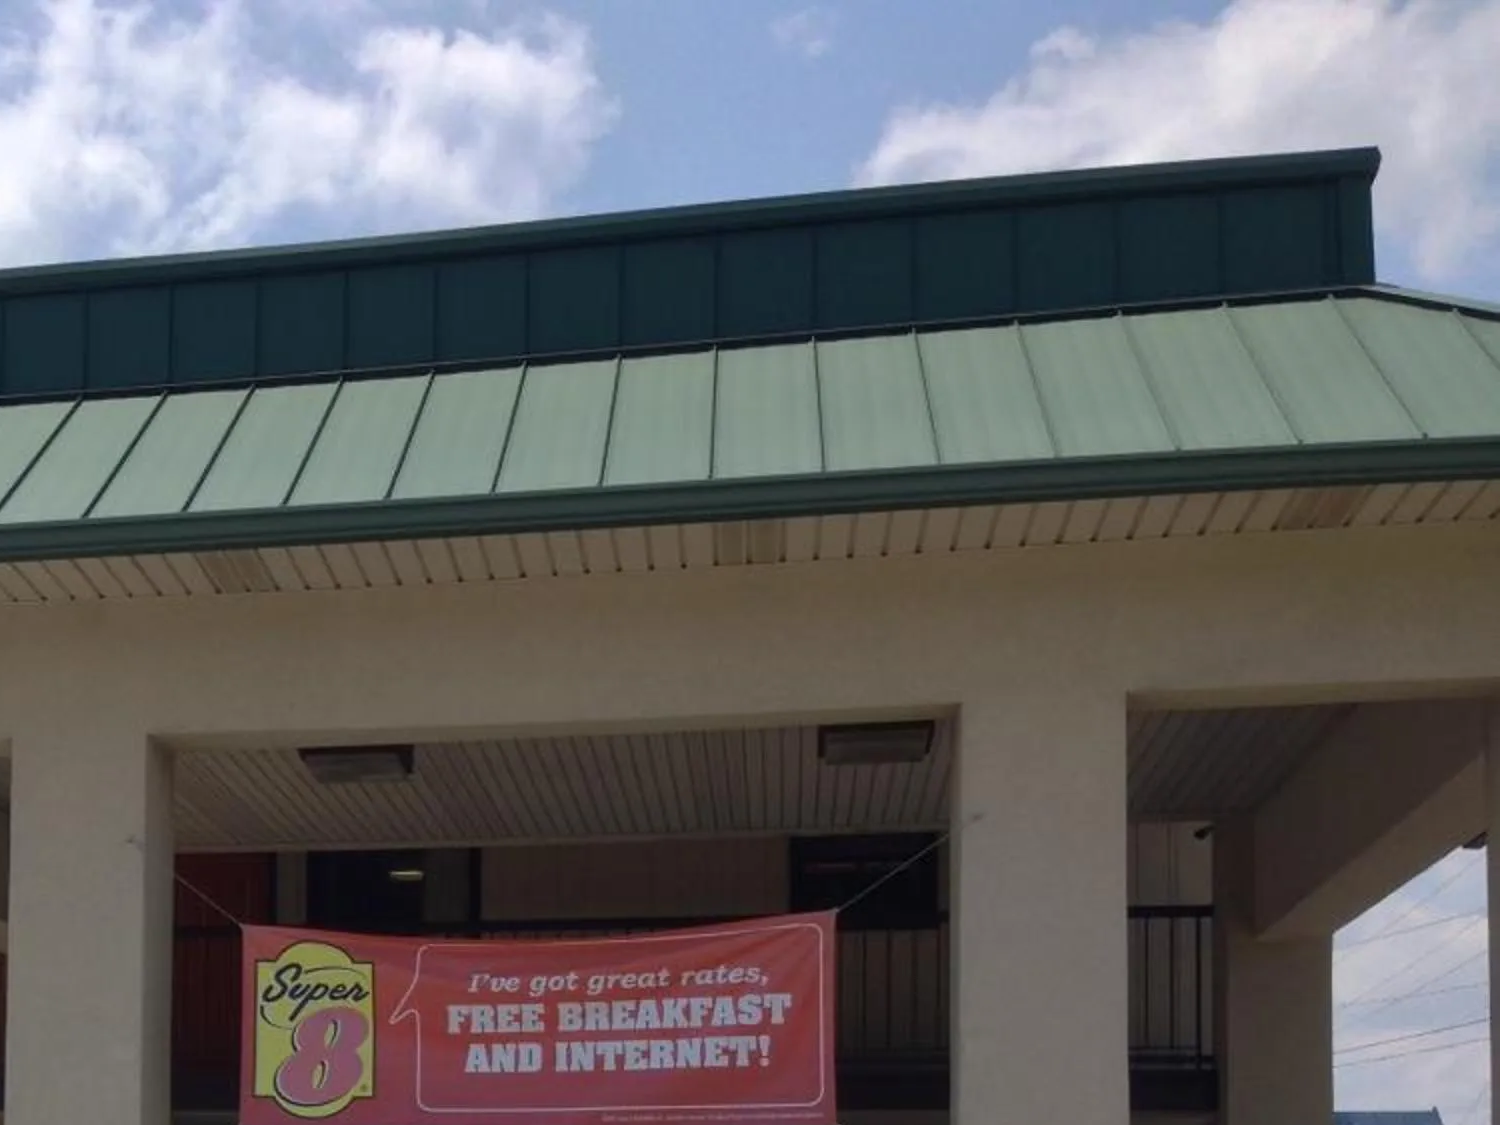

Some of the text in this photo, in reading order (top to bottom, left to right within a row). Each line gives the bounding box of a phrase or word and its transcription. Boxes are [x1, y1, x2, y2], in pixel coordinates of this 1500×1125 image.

[262, 963, 370, 1021] Super
[468, 964, 769, 996] I've got great rates,
[447, 993, 792, 1034] FREE BREAKFAST
[274, 1005, 370, 1107] 8
[465, 1035, 771, 1073] AND INTERNET!
